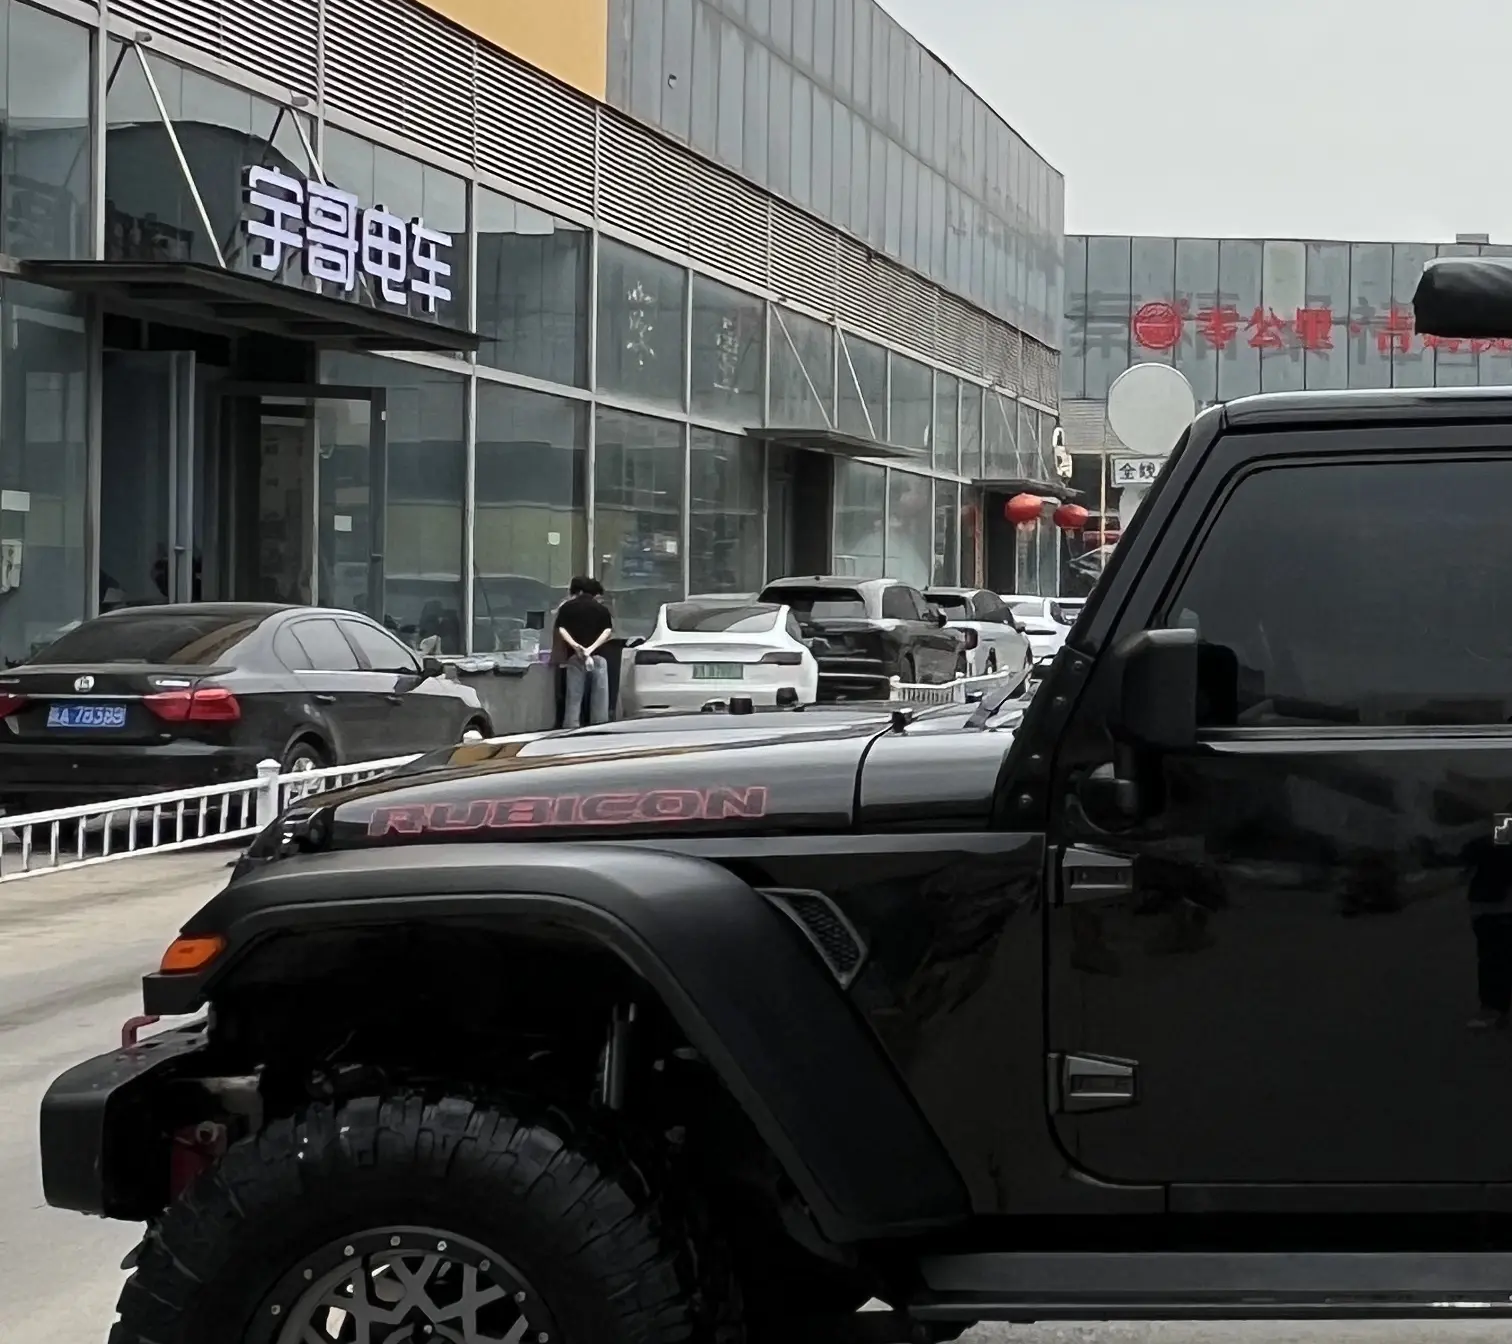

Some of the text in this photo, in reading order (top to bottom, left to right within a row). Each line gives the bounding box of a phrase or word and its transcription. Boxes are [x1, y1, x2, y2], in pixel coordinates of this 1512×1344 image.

[247, 164, 453, 313] 宇哥电车
[367, 785, 768, 837] RUBICON
